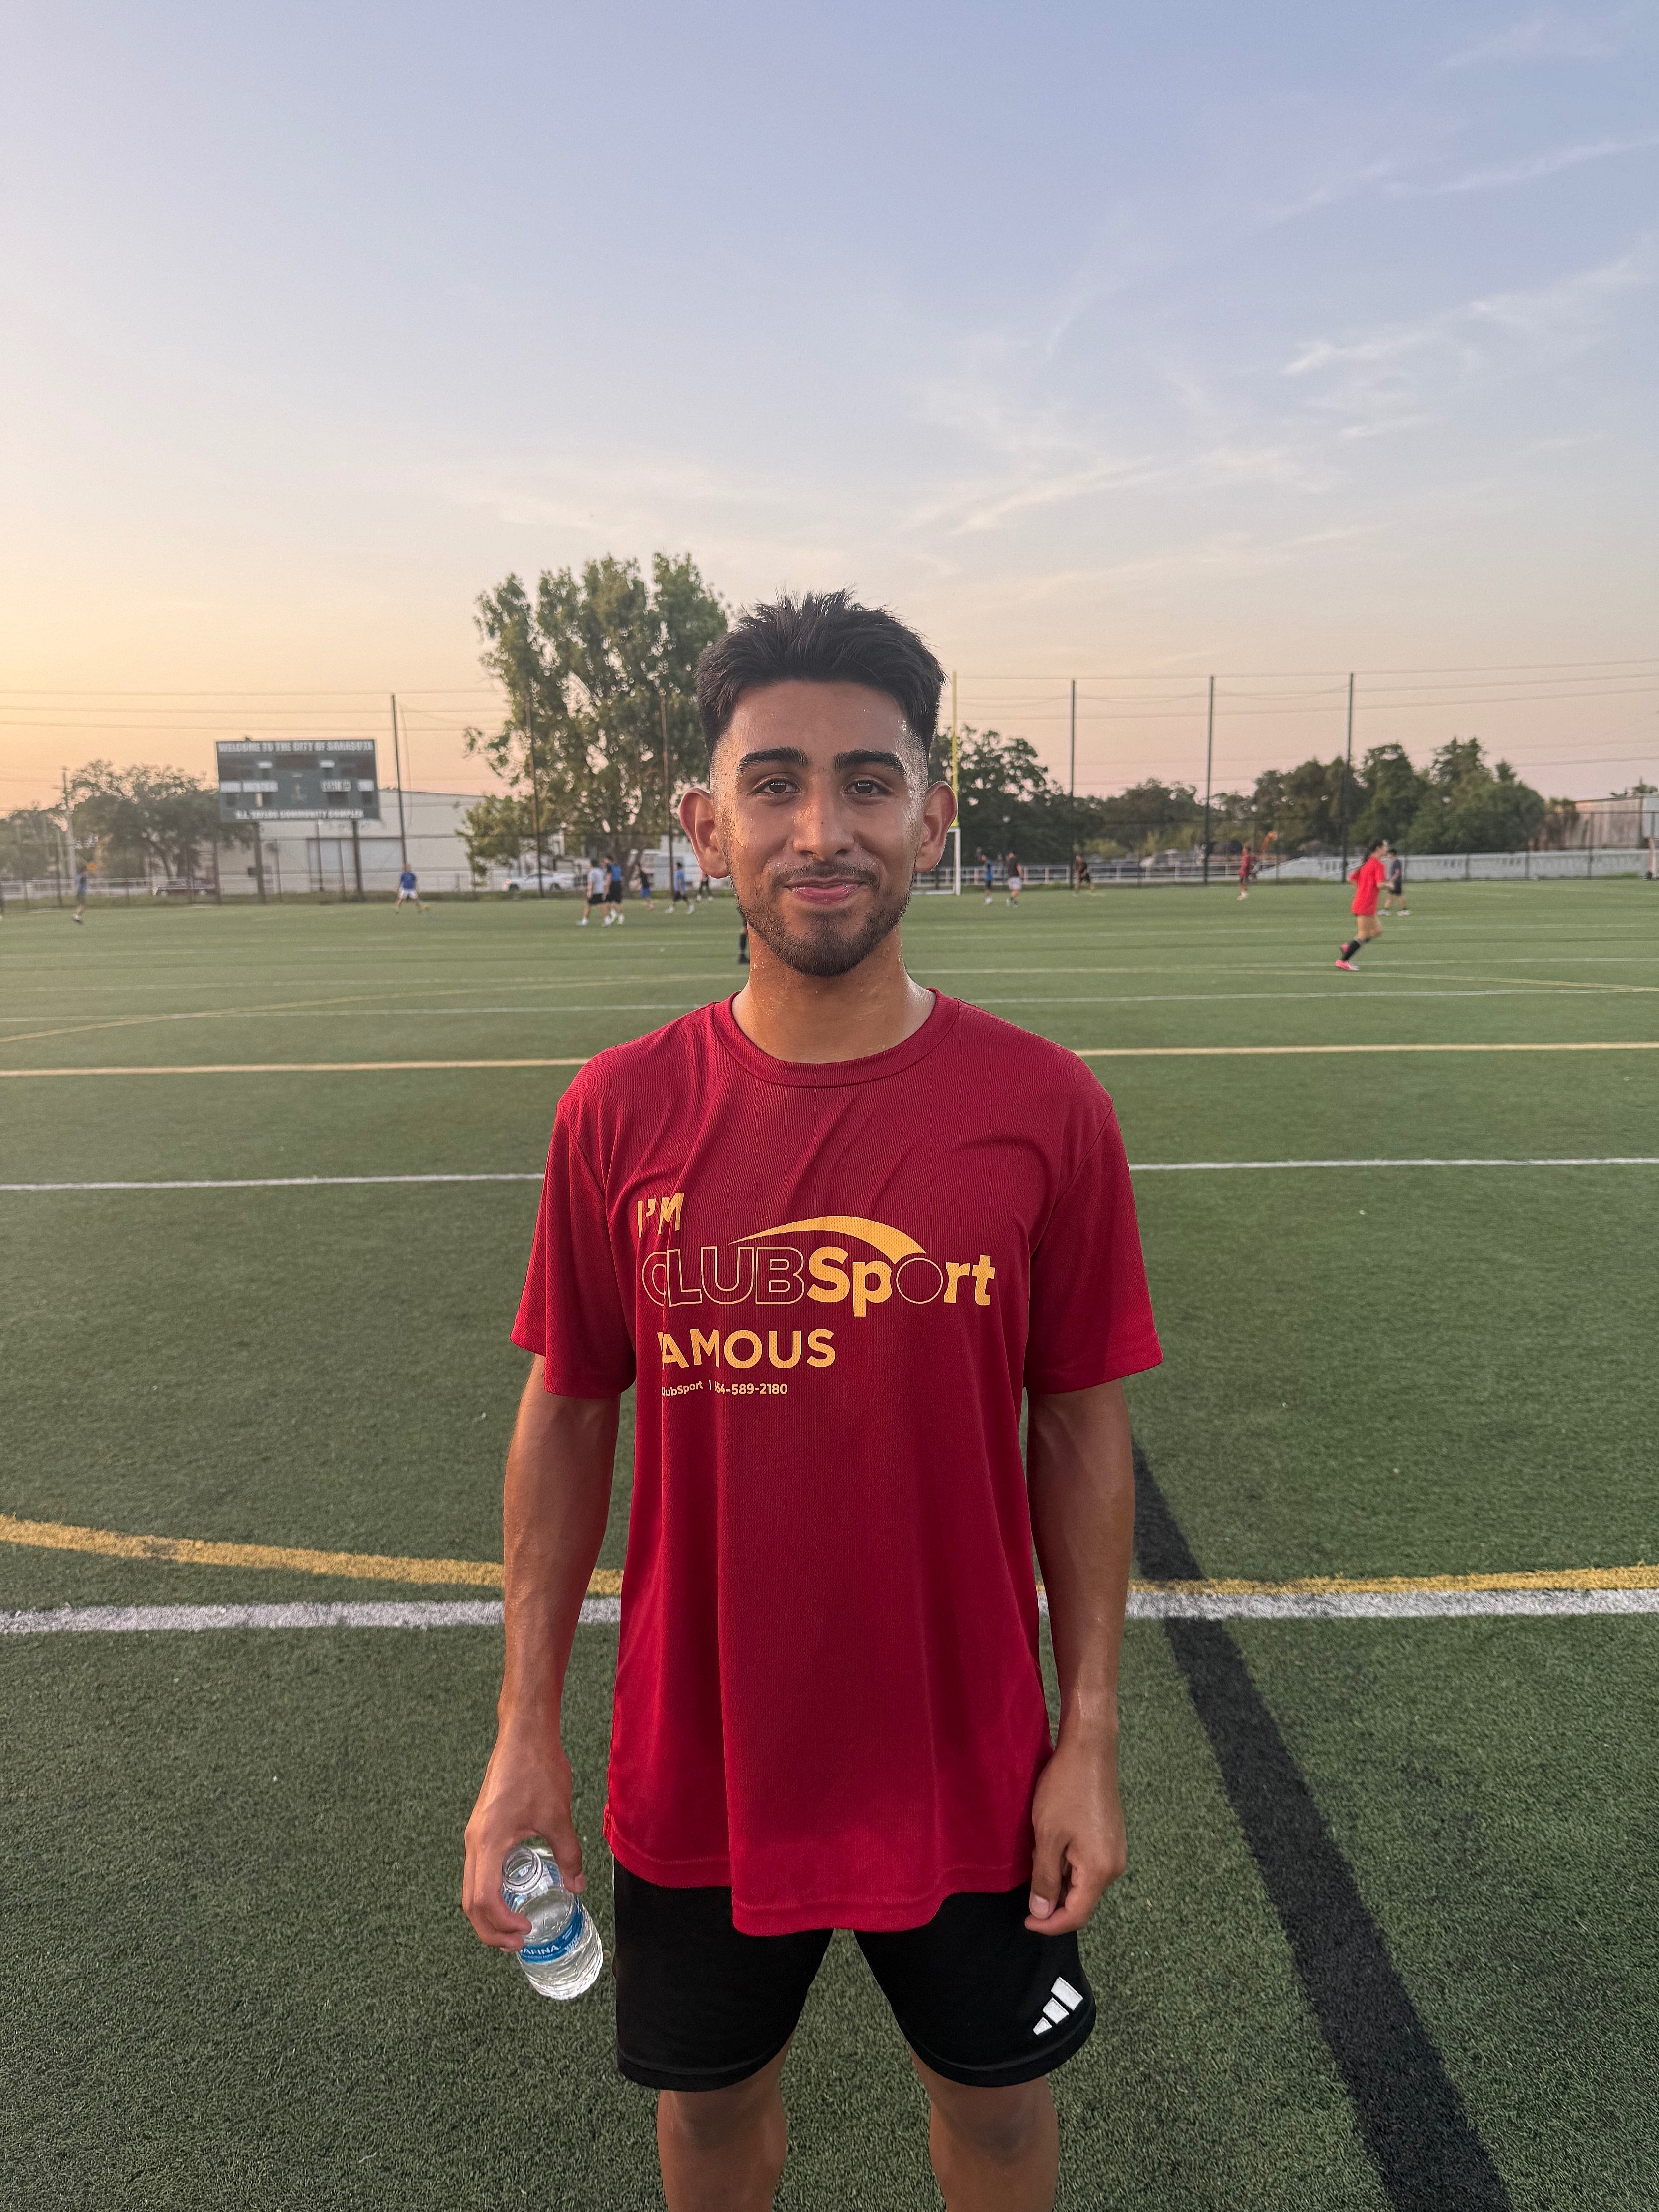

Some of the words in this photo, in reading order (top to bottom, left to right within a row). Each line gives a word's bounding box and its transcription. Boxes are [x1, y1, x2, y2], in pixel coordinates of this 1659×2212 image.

[637, 1193, 685, 1238] I'M
[657, 1328, 836, 1370] AMOUS
[662, 1381, 704, 1396] lubSport
